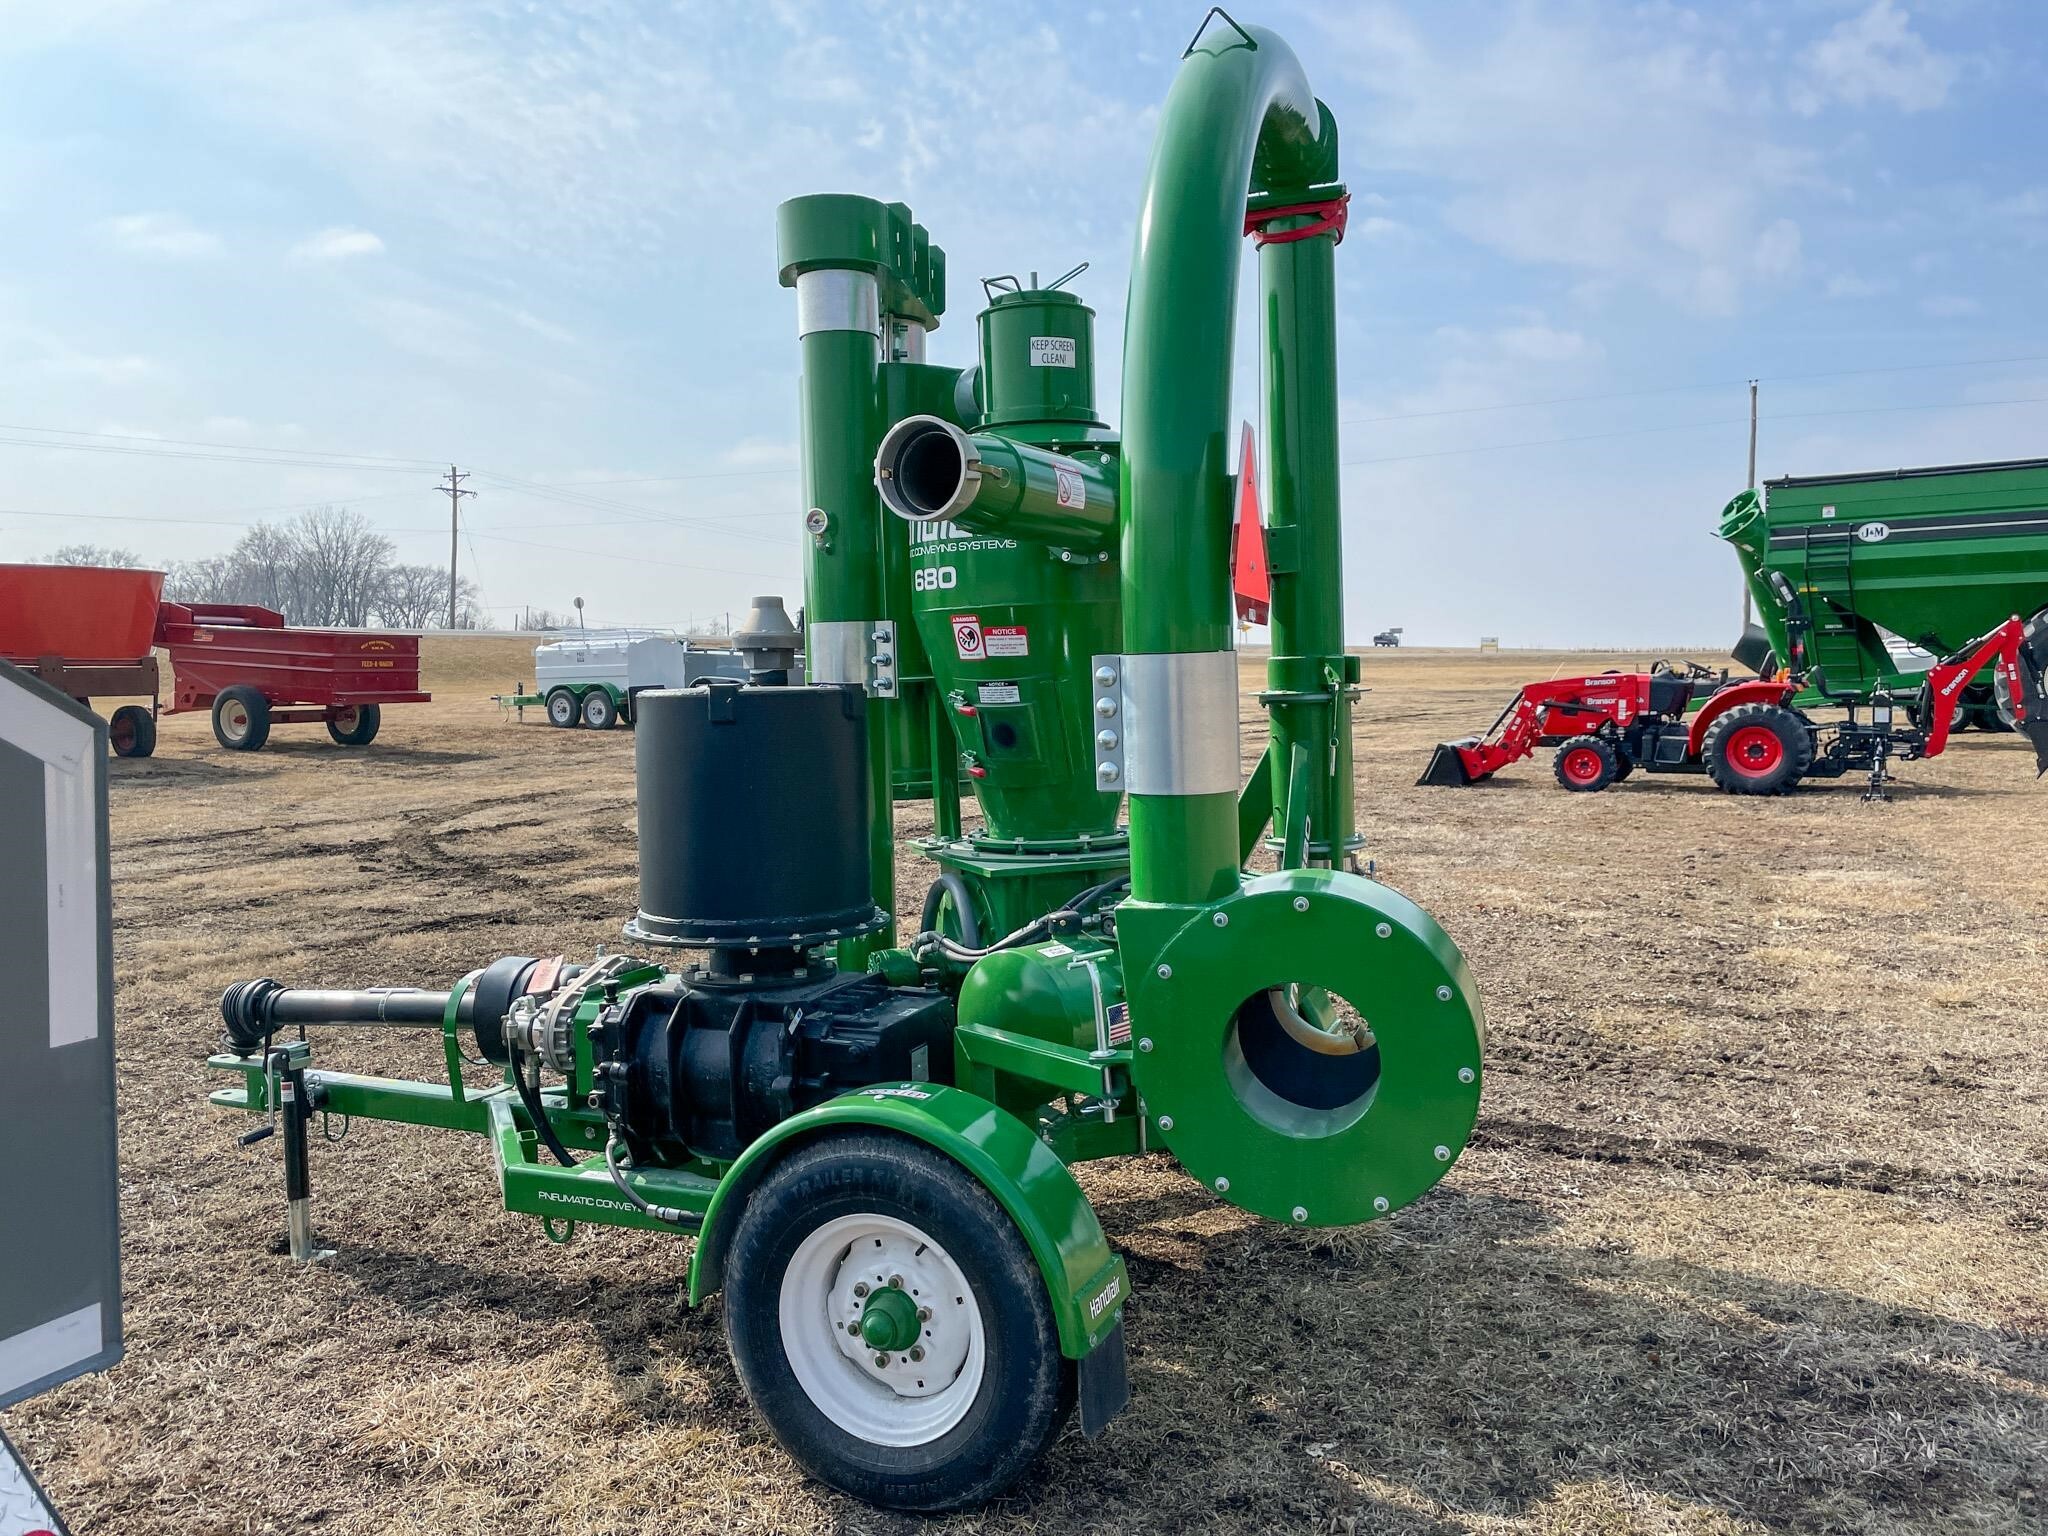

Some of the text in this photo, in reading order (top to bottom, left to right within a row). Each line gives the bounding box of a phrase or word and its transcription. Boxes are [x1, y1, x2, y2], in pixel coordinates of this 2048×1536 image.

[1031, 339, 1074, 352] KEEP SCREEN
[1041, 352, 1067, 364] CLEAN!
[1861, 526, 1884, 538] J&M
[914, 542, 957, 557] CONVEYING
[958, 539, 1017, 551] SYSTEMS
[914, 566, 957, 592] 680
[1584, 678, 1617, 686] Branson
[1940, 668, 1969, 696] Branson
[538, 1190, 642, 1213] PNEUMATIC CONVEY
